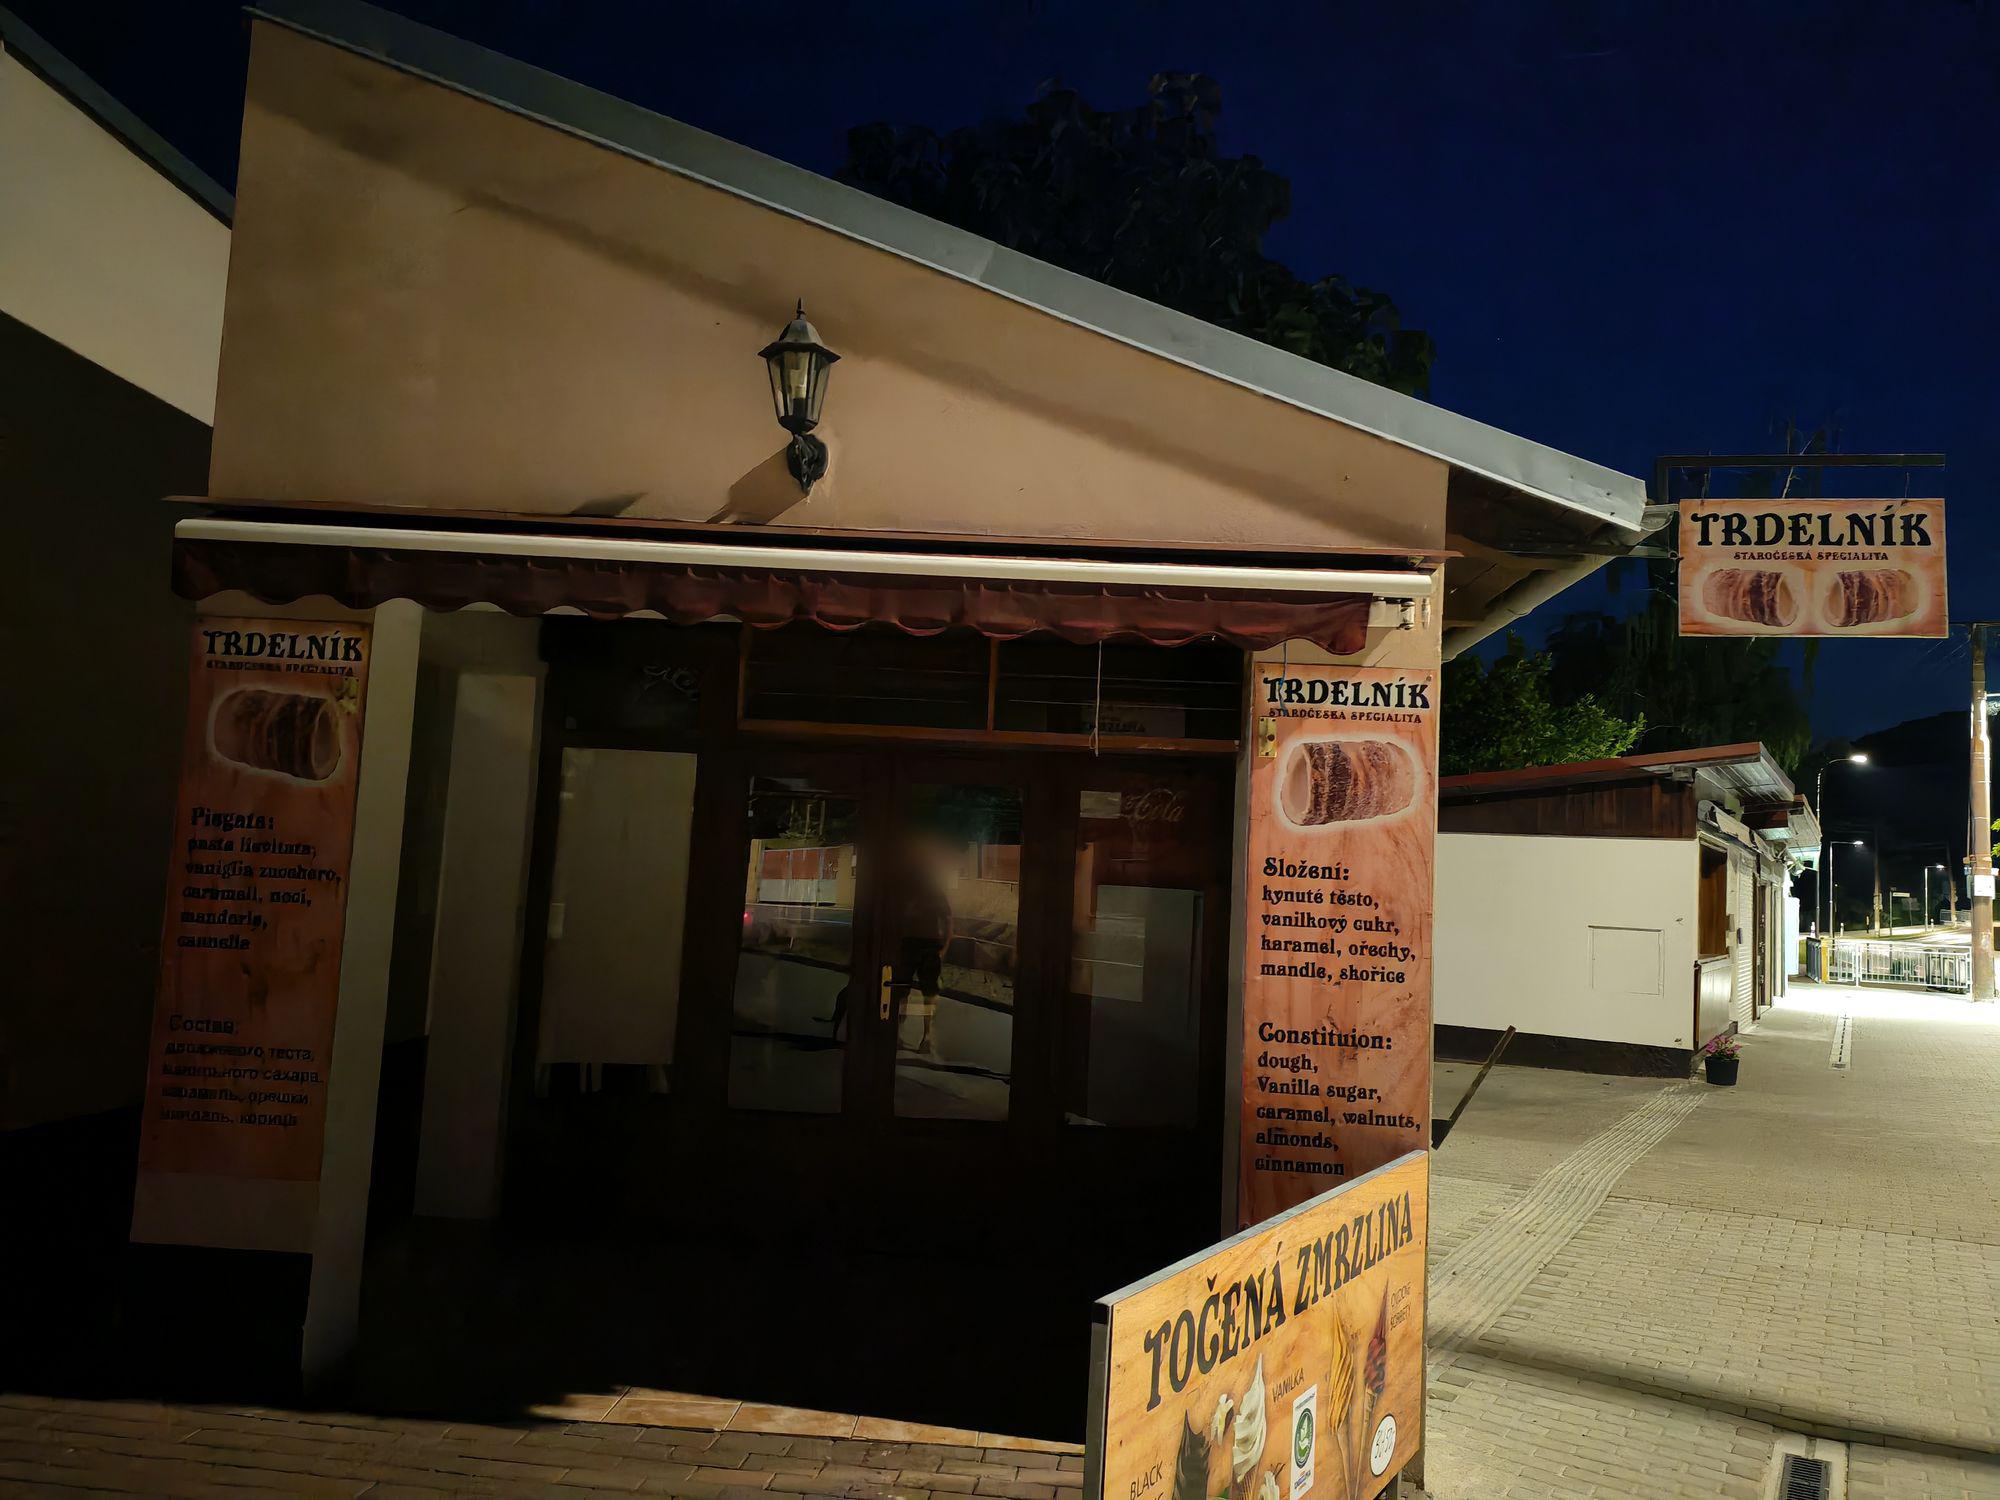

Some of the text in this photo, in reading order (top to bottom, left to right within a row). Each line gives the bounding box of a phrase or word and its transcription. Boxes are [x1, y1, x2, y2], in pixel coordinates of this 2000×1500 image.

[1691, 505, 1931, 546] TRDELNÍK
[1816, 551, 1888, 561] SPECIALITA
[203, 630, 362, 661] TRDELNÍK
[1263, 676, 1430, 709] TRDELNÍK
[1351, 710, 1422, 724] SPECIALITA
[259, 865, 341, 884] zucchero,
[1263, 857, 1349, 881] Složení:
[1262, 885, 1379, 910] kynuté těsto,
[1261, 911, 1400, 935] vanilkový cukr,
[1260, 935, 1416, 962] karamel, ořechy,
[1260, 962, 1406, 984] mandle, skořice
[1258, 1023, 1392, 1050] Constituion:
[1257, 1051, 1319, 1073] dough,
[1257, 1076, 1382, 1103] Vanilla sugar,
[1256, 1106, 1421, 1131] caramel, walnuts,
[1255, 1128, 1339, 1151] almonds,
[1255, 1154, 1345, 1176] cinnamon
[1143, 1190, 1413, 1412] TOČENÁ ZMRZLINA
[1271, 1368, 1305, 1402] VANILKA
[1130, 1460, 1163, 1500] BLACK
